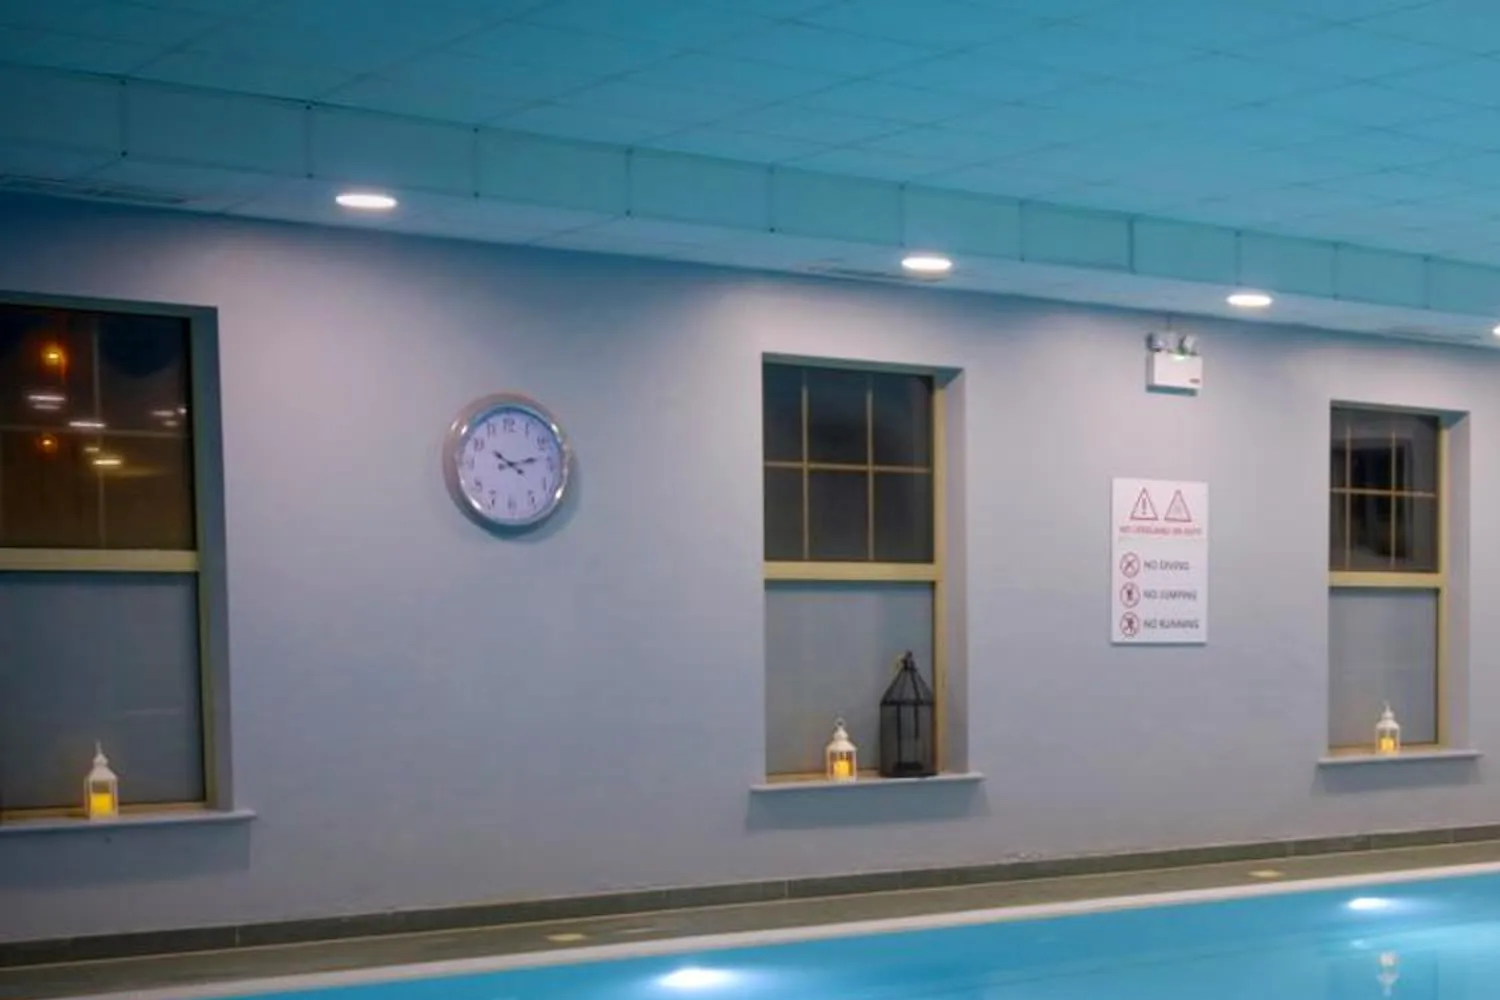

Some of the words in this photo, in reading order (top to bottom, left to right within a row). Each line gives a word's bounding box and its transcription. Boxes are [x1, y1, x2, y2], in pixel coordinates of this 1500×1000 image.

[503, 418, 515, 433] 12
[1144, 560, 1157, 569] NO
[1160, 560, 1190, 571] DIVING
[1143, 590, 1157, 599] NO
[1160, 590, 1197, 601] JUMPING
[1144, 619, 1157, 628] NO
[1159, 619, 1199, 629] RUNNING
